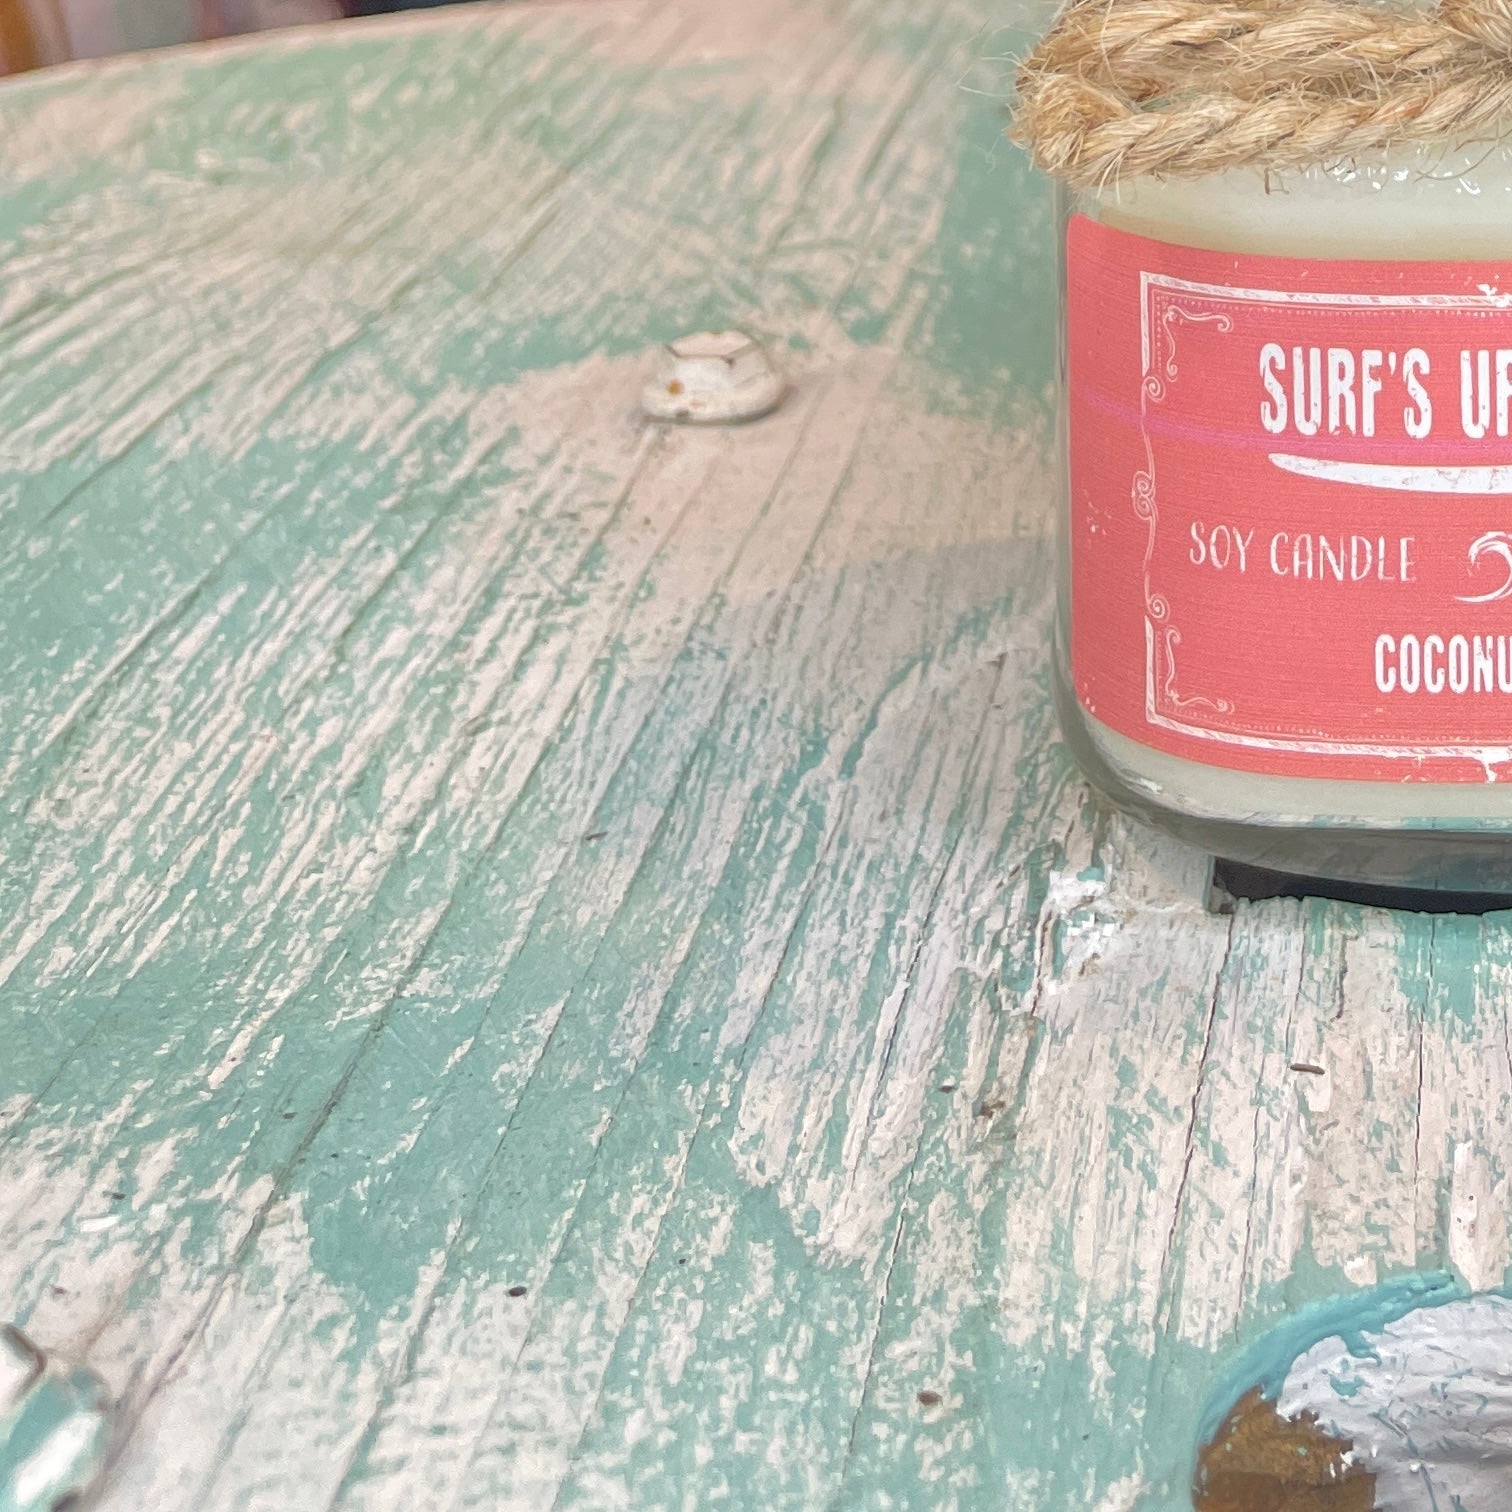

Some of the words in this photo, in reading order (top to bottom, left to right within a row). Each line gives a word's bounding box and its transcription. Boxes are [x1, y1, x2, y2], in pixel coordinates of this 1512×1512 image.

[1259, 343, 1433, 439] SURF'S
[1189, 522, 1254, 572] SOY
[1270, 531, 1416, 582] CANDLE
